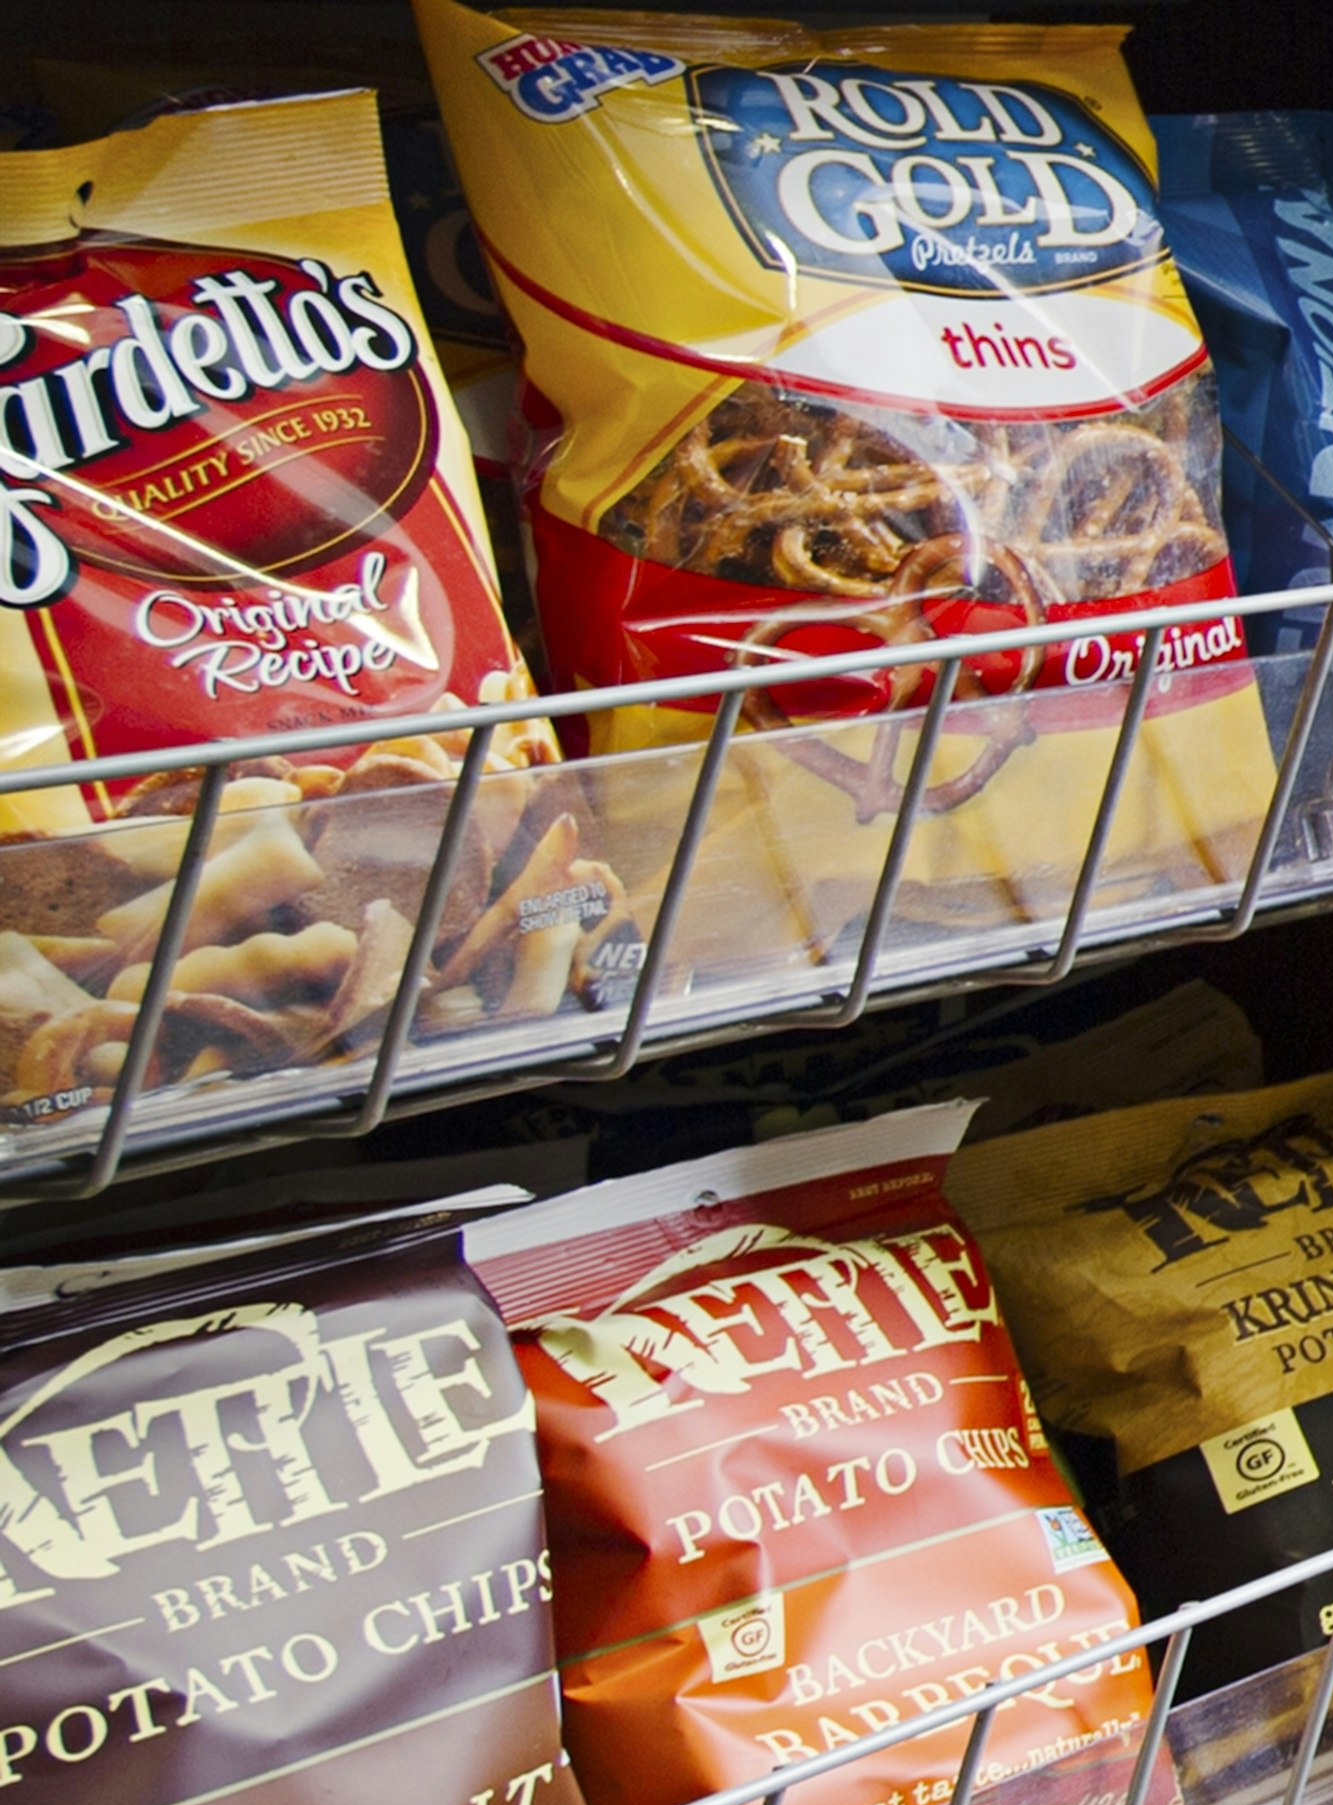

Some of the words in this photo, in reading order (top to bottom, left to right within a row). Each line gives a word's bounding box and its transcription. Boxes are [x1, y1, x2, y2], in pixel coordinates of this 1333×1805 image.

[489, 38, 583, 80] HU
[777, 72, 1062, 149] ROLD
[776, 147, 1138, 258] GOLD
[911, 234, 1036, 272] Pretzels
[941, 322, 1077, 373] thins
[92, 452, 230, 522] QUALITY
[239, 416, 311, 462] SINCE
[313, 405, 372, 436] 1932
[135, 552, 387, 646] Original
[172, 637, 397, 700] Recipe
[1064, 617, 1243, 694] Orginal
[55, 1086, 94, 1111] CUP
[508, 1222, 1001, 1443] KETTLE
[780, 1370, 945, 1438] BRAND
[0, 1305, 537, 1608] ETTLE
[1245, 1448, 1275, 1471] GF
[666, 1447, 918, 1565] POTATO
[935, 1427, 1030, 1476] CHIPS
[151, 1529, 390, 1633] BRAND
[0, 1632, 338, 1786] POTATO
[362, 1548, 554, 1656] CHIPS
[741, 1628, 764, 1647] GF
[786, 1582, 1066, 1708] BACKYARD
